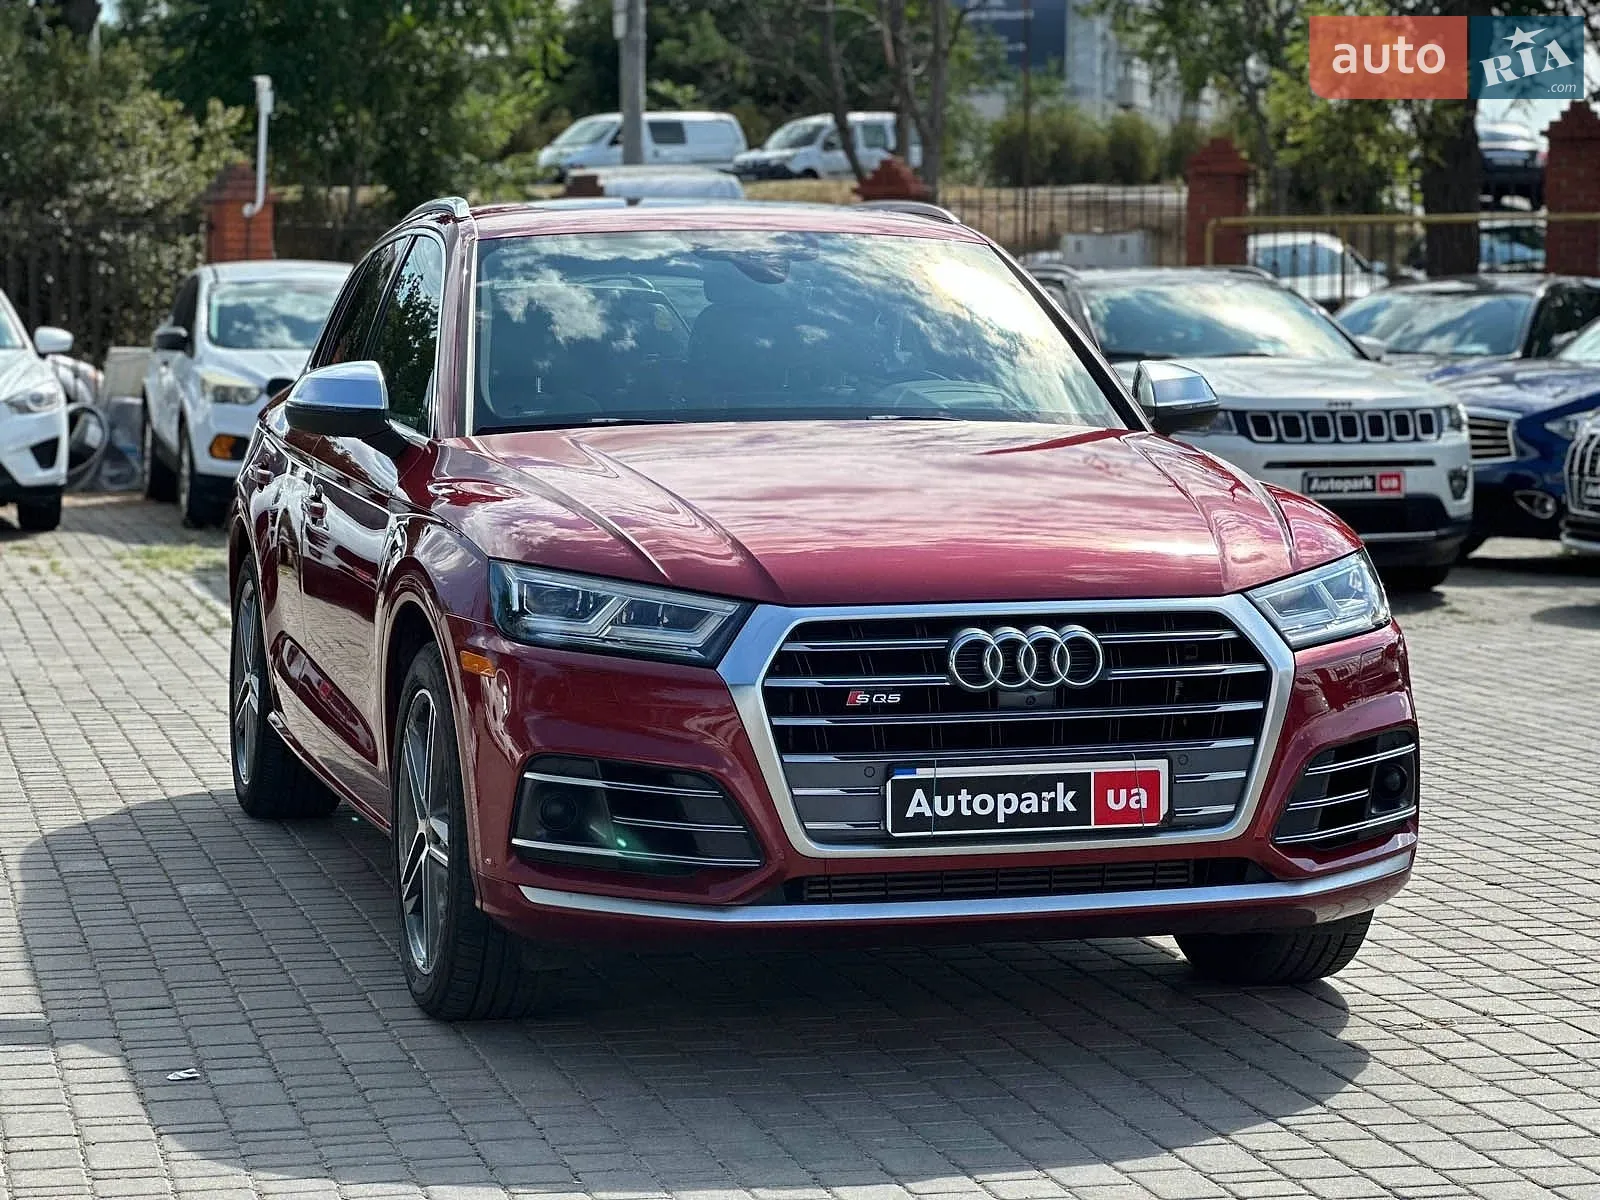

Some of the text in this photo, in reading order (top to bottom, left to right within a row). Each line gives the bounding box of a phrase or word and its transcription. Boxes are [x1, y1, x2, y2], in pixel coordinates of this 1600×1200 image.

[1310, 476, 1373, 491] Autopark
[905, 782, 1148, 823] Autopark ua
